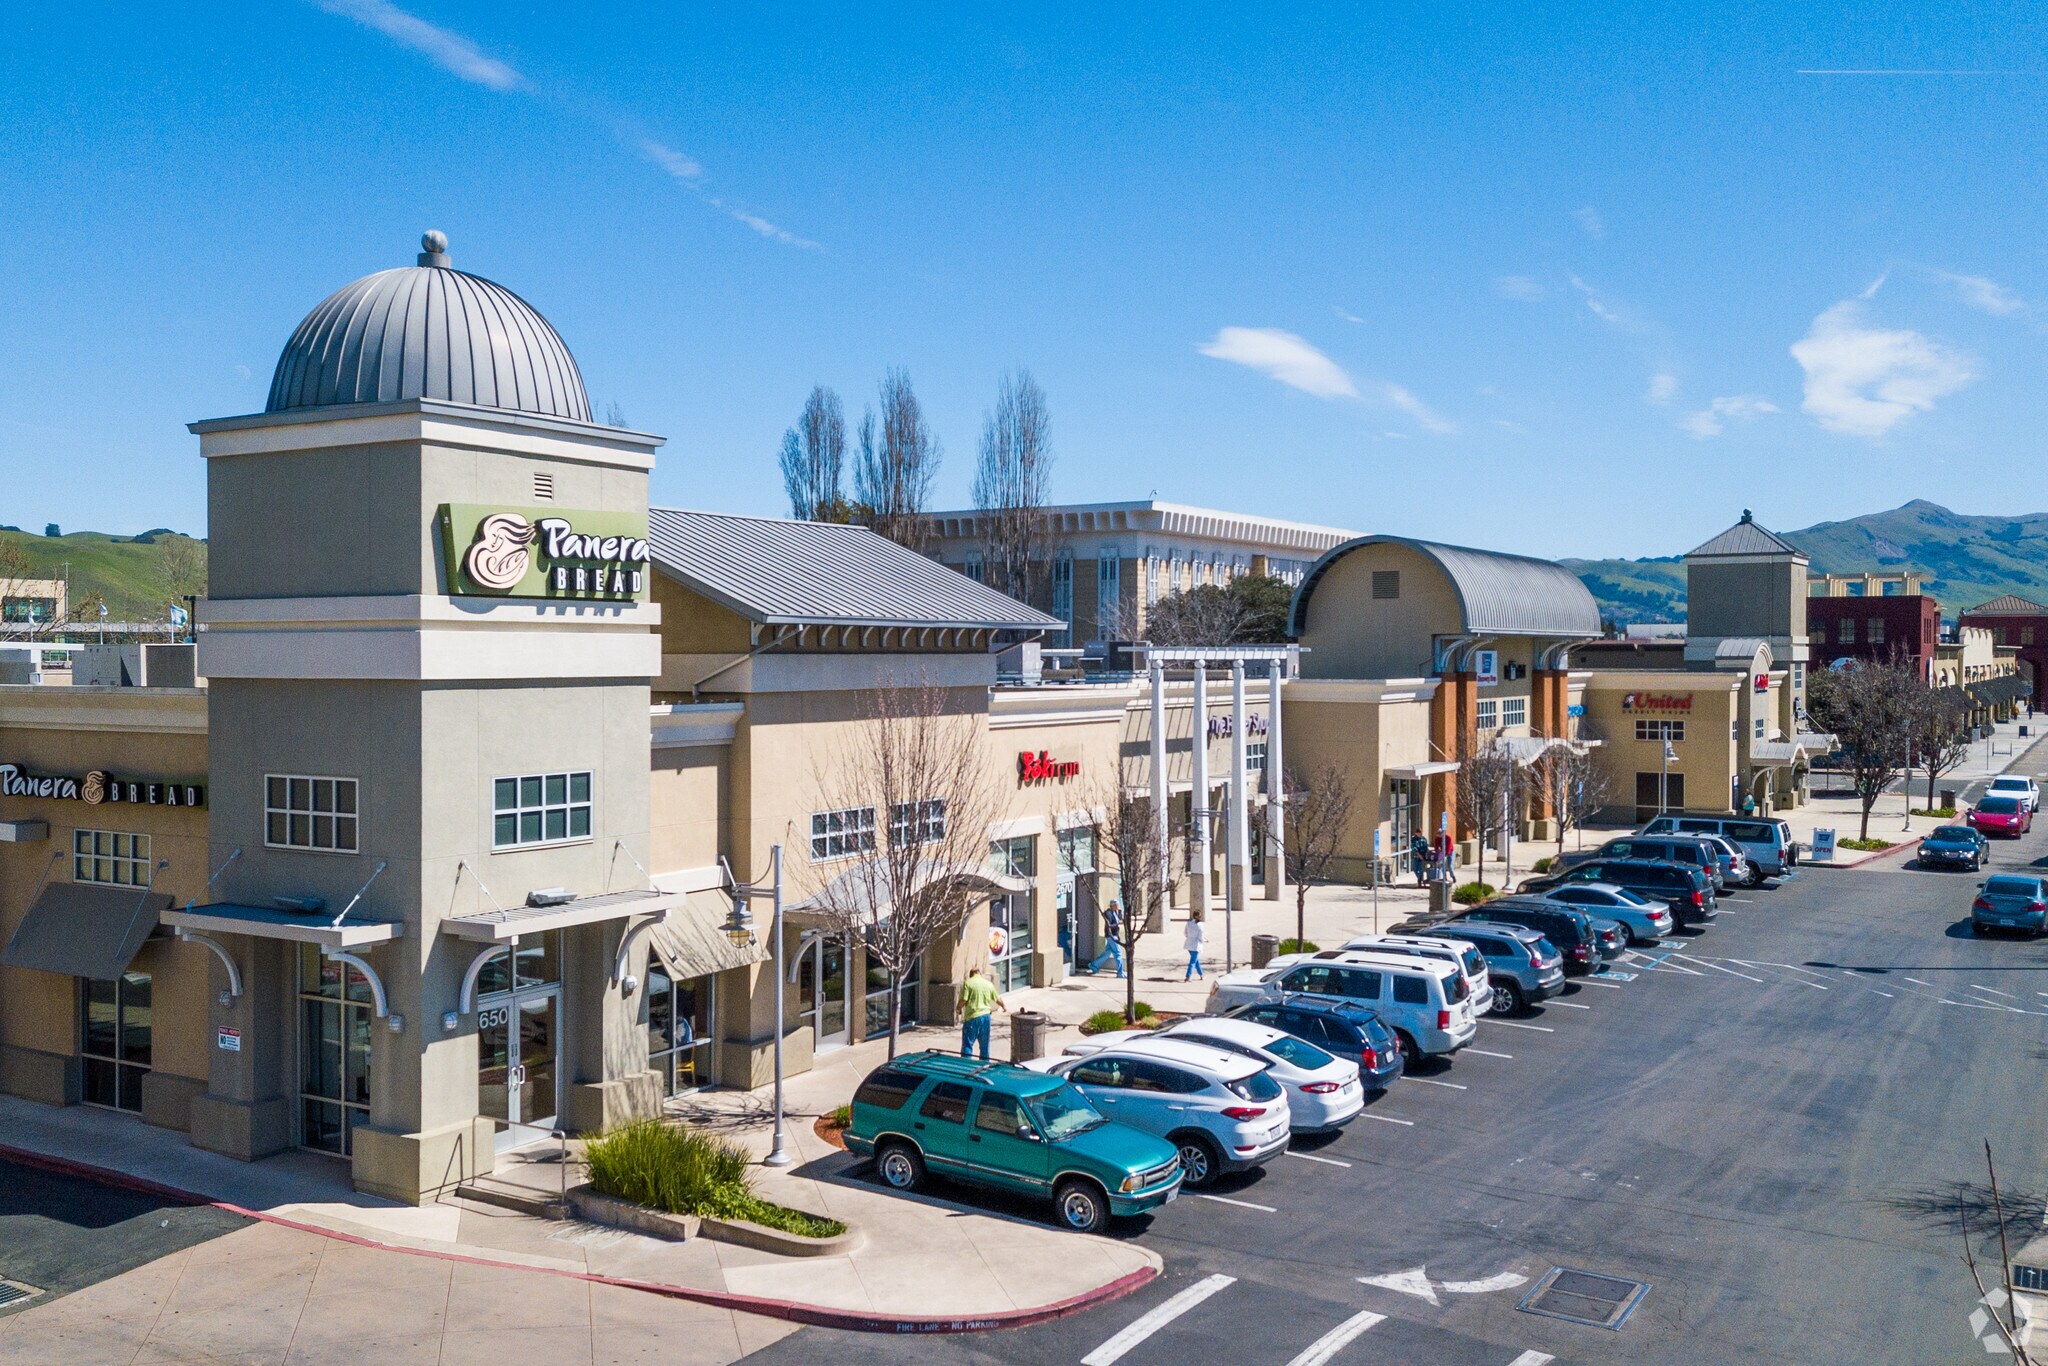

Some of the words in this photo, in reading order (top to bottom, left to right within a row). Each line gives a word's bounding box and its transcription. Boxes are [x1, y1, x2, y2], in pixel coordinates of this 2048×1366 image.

[541, 518, 651, 562] Panera
[556, 567, 641, 592] BREAD
[1634, 691, 1693, 710] United
[0, 764, 77, 799] Panera
[111, 782, 196, 806] BREAD
[1814, 846, 1832, 854] OPEN
[1056, 881, 1073, 896] 2670
[479, 1007, 508, 1028] 650
[896, 1323, 914, 1332] FIRE
[919, 1323, 940, 1331] LANE
[951, 1321, 963, 1330] NO
[966, 1320, 1000, 1329] PARKING
